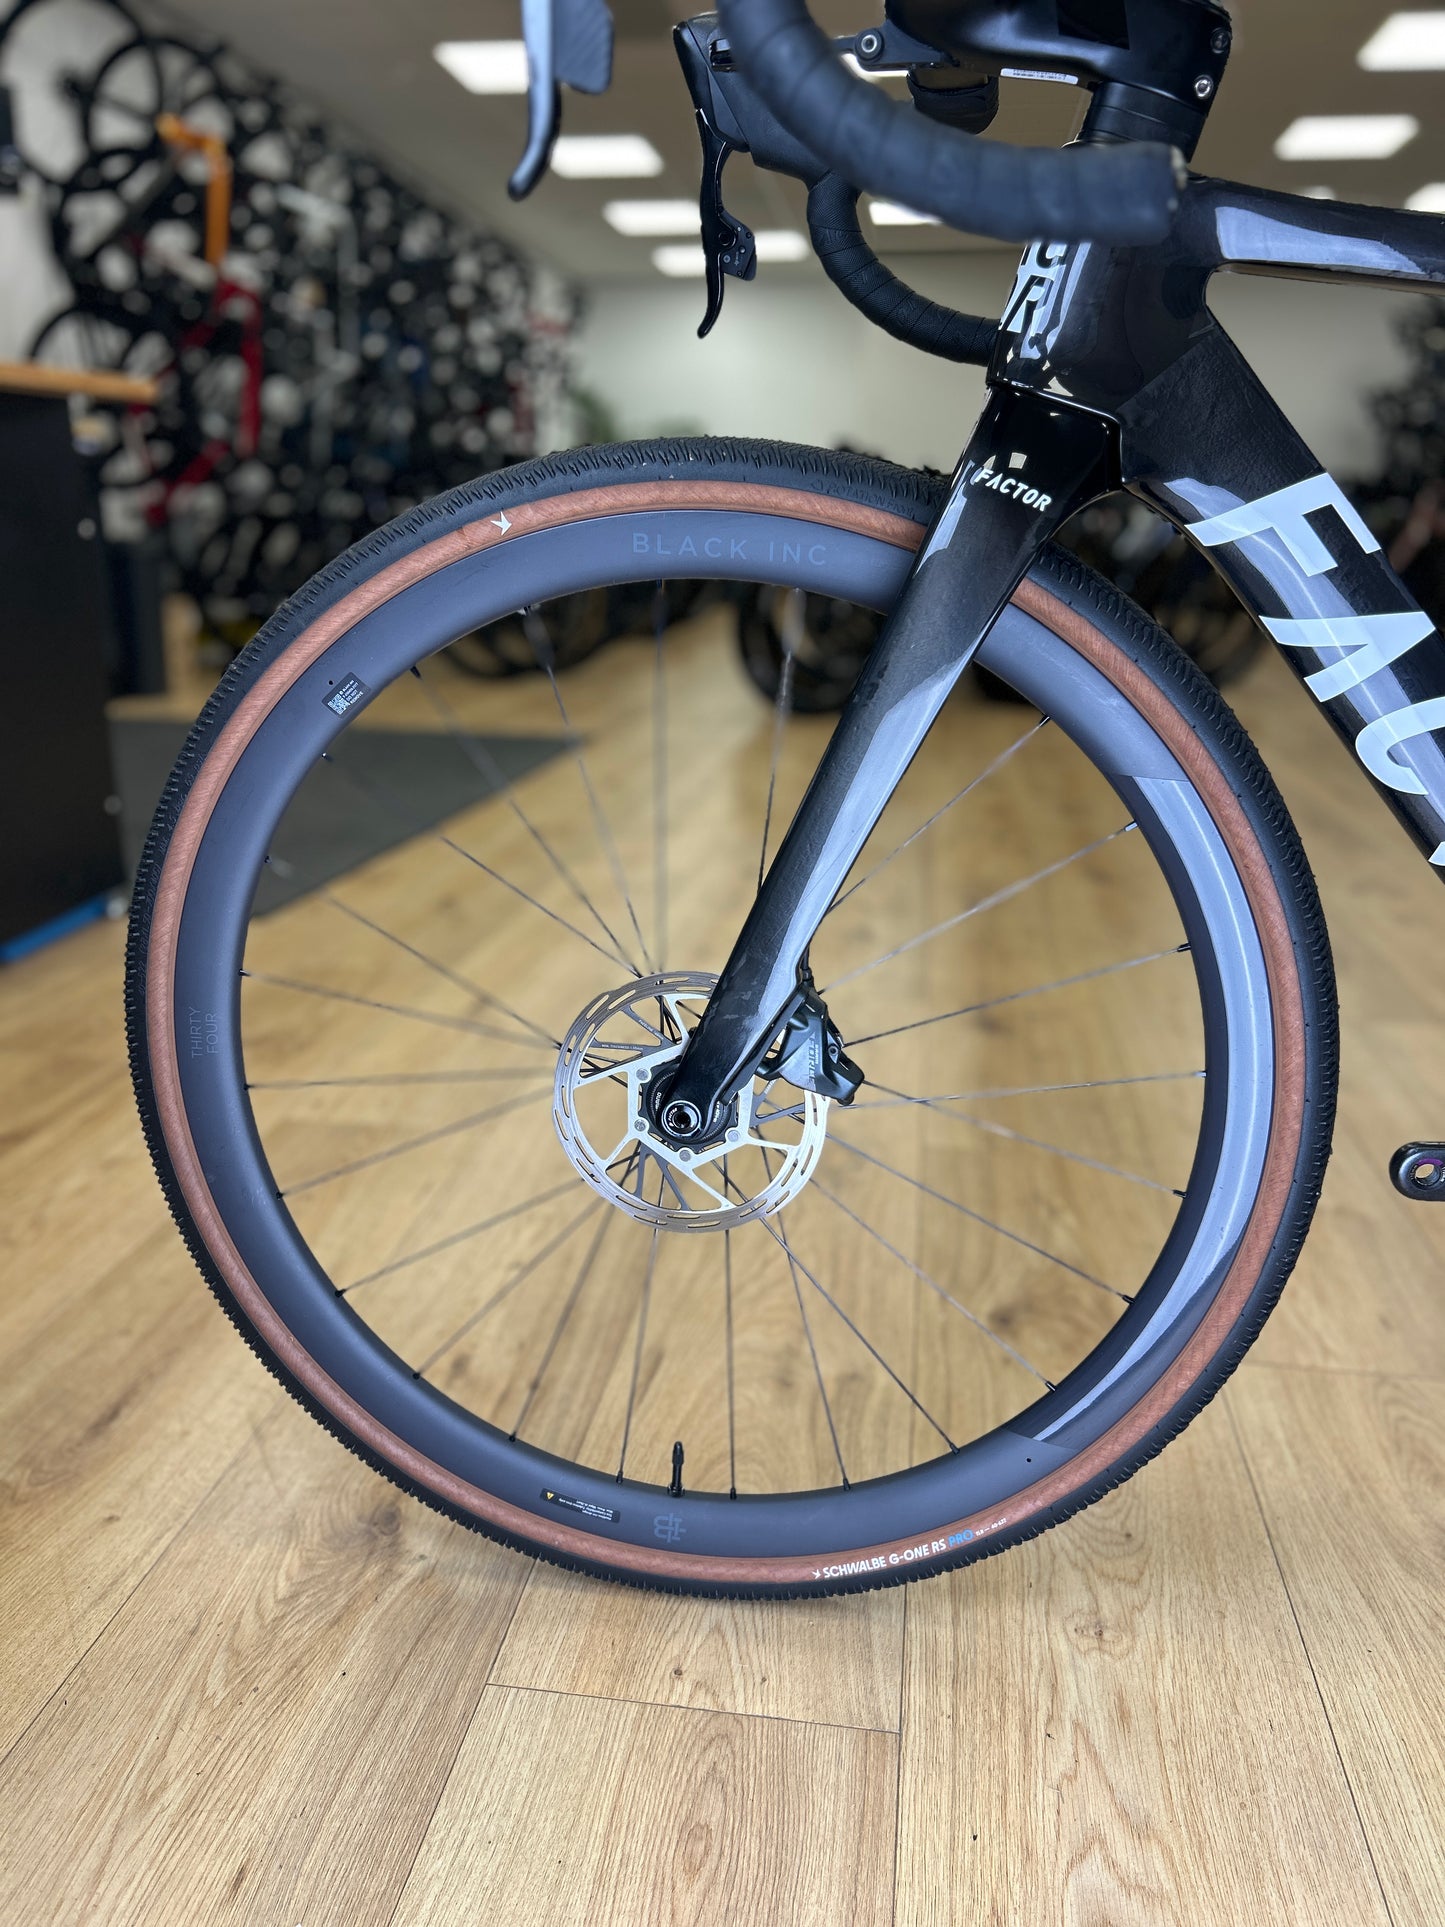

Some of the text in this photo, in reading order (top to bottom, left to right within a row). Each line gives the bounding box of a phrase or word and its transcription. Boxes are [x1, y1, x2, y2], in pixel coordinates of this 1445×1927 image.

[973, 467, 1052, 512] FACTOR
[632, 532, 827, 566] BLACK INC
[1184, 472, 1445, 867] FAC
[188, 1006, 203, 1059] THIRTY
[205, 1013, 219, 1054] FOUR
[822, 1555, 887, 1579] SCHWALBE
[888, 1543, 930, 1565] G-ONE
[931, 1538, 947, 1554] RS
[948, 1528, 975, 1548] PRO
